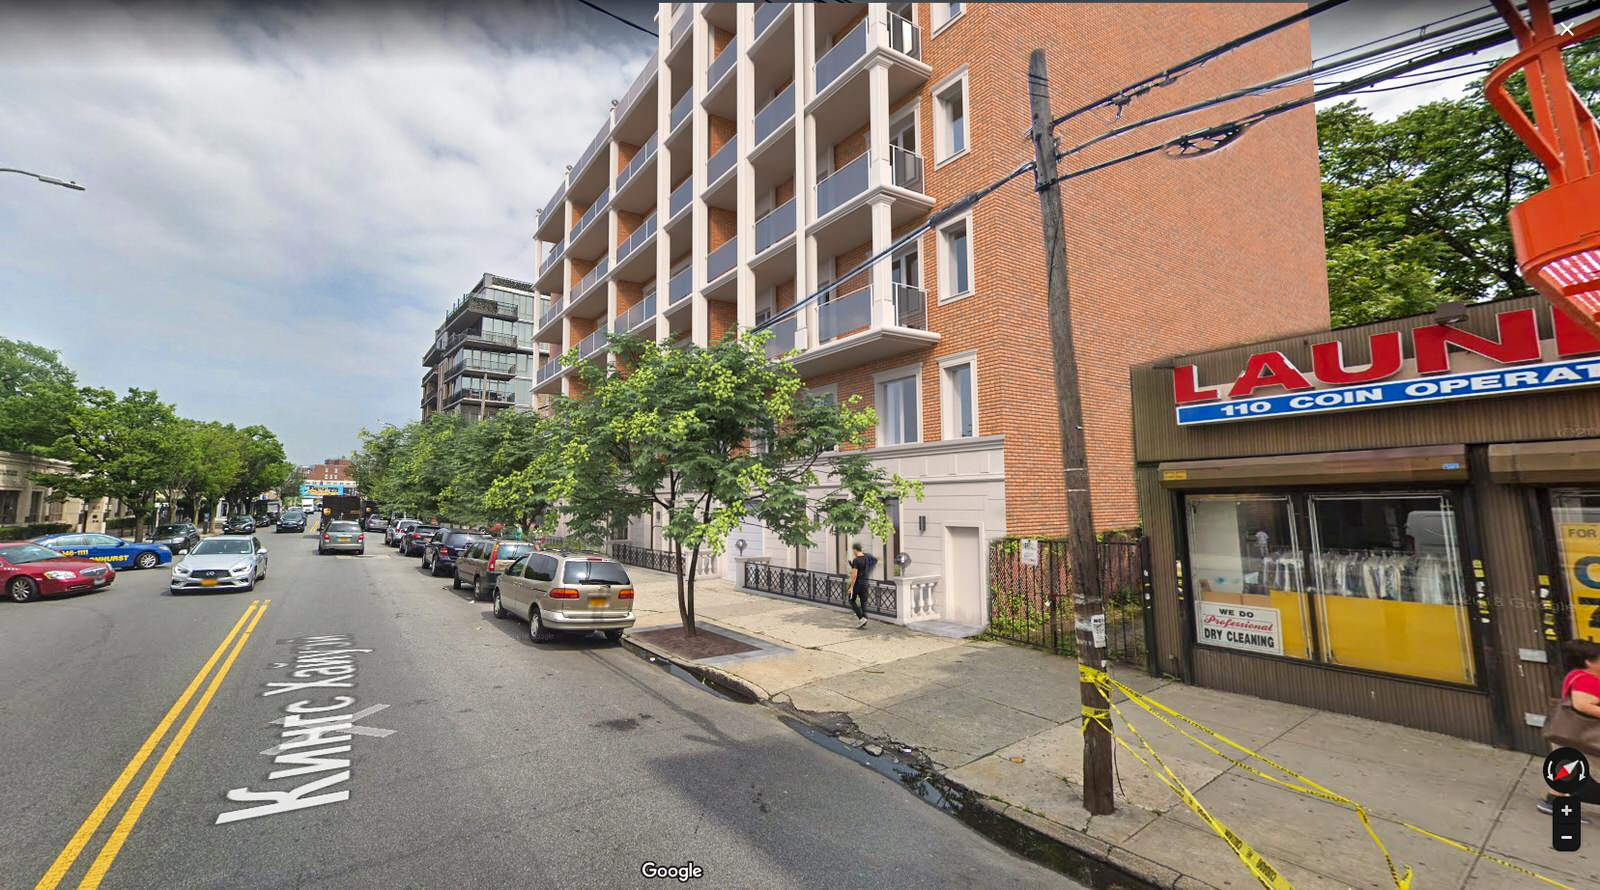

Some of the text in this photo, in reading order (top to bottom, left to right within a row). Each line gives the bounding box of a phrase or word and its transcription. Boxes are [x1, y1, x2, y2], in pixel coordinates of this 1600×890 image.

[1221, 401, 1271, 416] 110
[1289, 388, 1382, 409] COIN
[1568, 528, 1597, 538] FOR
[1219, 608, 1254, 618] WE DO
[1204, 615, 1273, 631] Professional
[1204, 628, 1275, 648] DRY CLEANING
